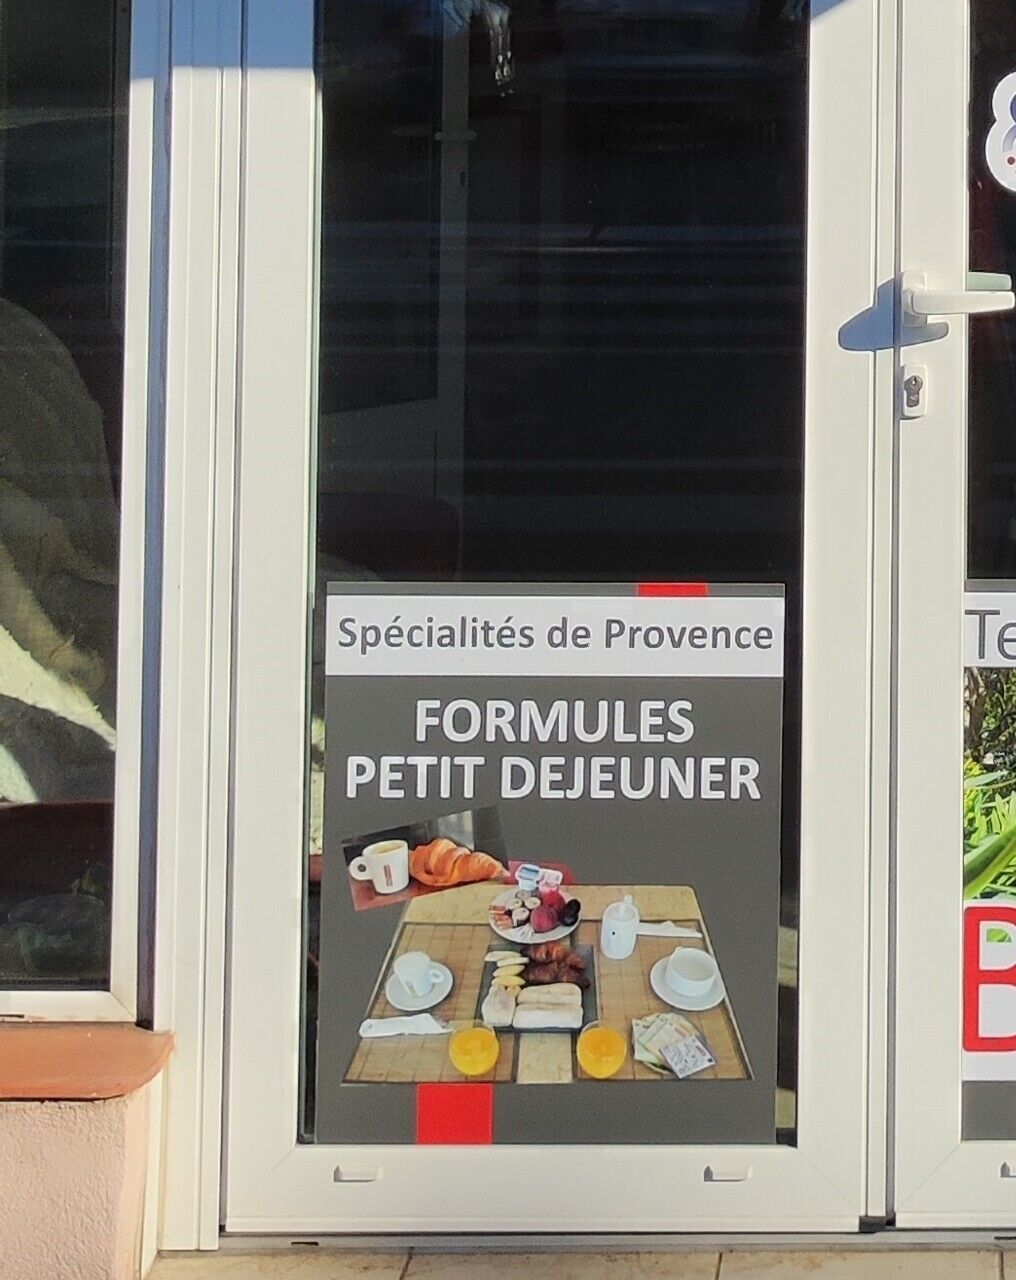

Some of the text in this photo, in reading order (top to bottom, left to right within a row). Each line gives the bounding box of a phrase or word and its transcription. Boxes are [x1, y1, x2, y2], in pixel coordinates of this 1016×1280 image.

[338, 616, 774, 654] Spécialités de Provence
[415, 698, 696, 743] FORMULES
[346, 755, 762, 800] PETIT DEJEUNER
